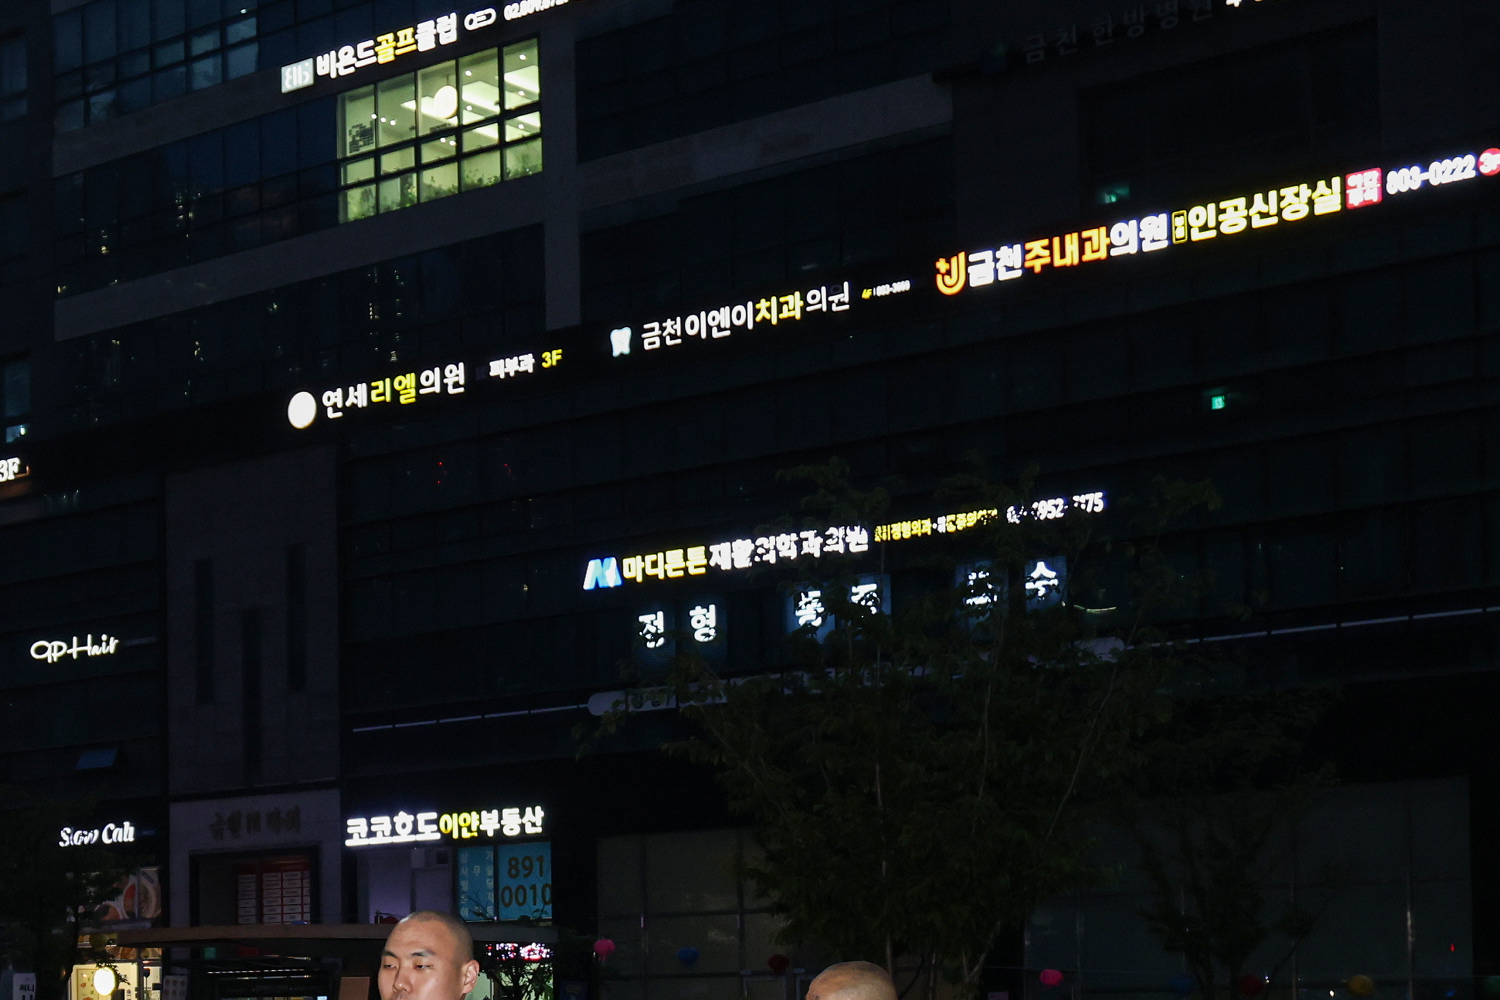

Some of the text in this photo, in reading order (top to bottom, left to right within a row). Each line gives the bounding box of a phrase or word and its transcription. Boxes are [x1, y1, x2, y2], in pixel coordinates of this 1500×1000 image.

[967, 213, 1169, 288] 금천주내과의원
[1187, 176, 1342, 242] 인공신장실
[322, 349, 562, 419] 연세리엘의원 피부과 3F
[344, 810, 441, 847] 코코호도
[507, 855, 545, 879] 891
[500, 882, 552, 908] 0010
